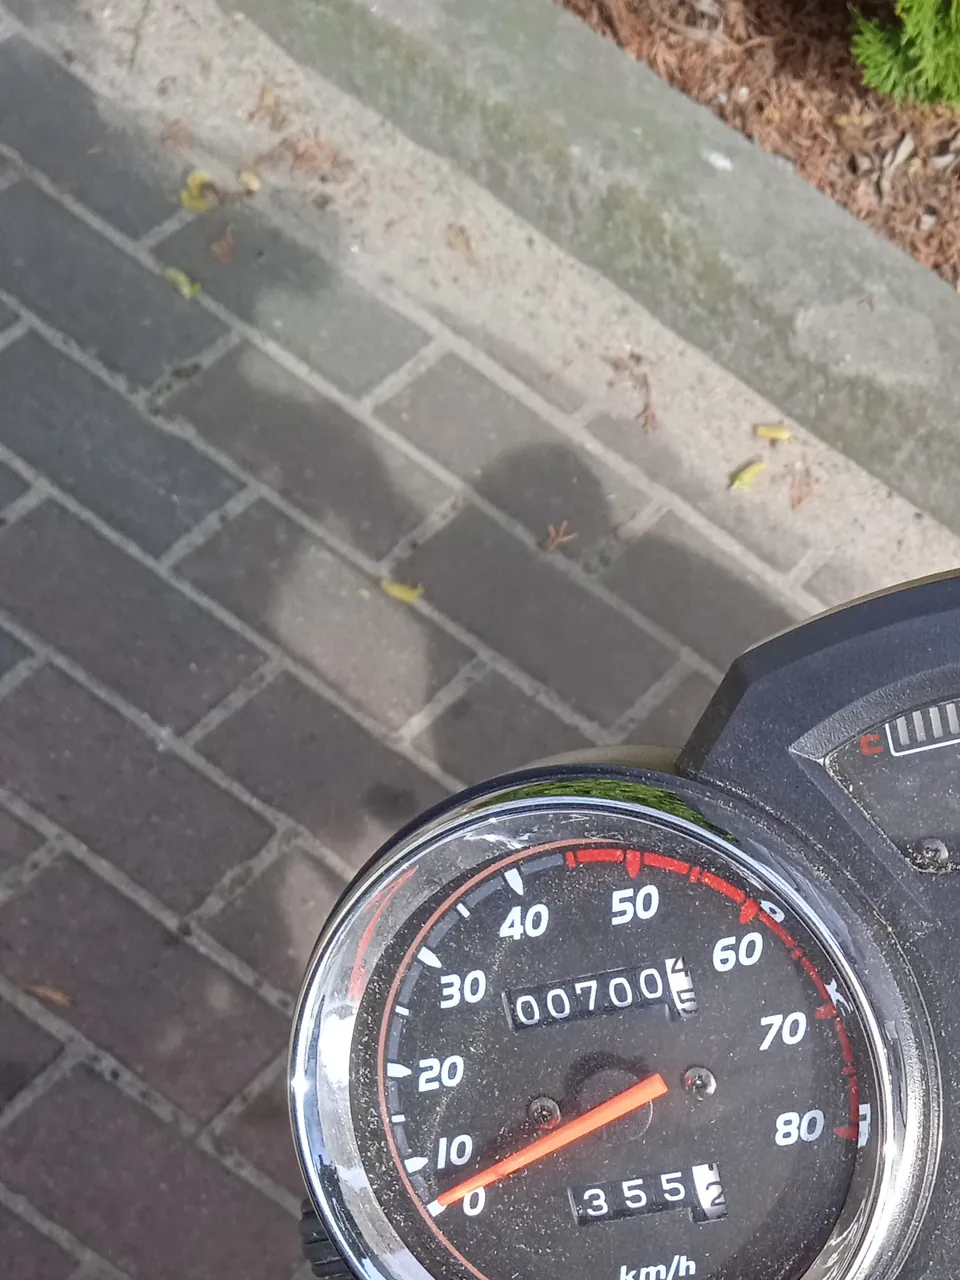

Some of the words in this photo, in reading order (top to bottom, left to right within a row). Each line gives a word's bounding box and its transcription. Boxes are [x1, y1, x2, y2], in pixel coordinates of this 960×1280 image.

[498, 903, 549, 941] 40
[611, 884, 660, 926] 50
[712, 931, 764, 972] 60
[440, 969, 487, 1009] 30
[759, 1011, 807, 1051] 70
[418, 1054, 465, 1093] 20
[774, 1109, 825, 1147] 80
[437, 1134, 473, 1170] 10
[462, 1186, 486, 1217] 0
